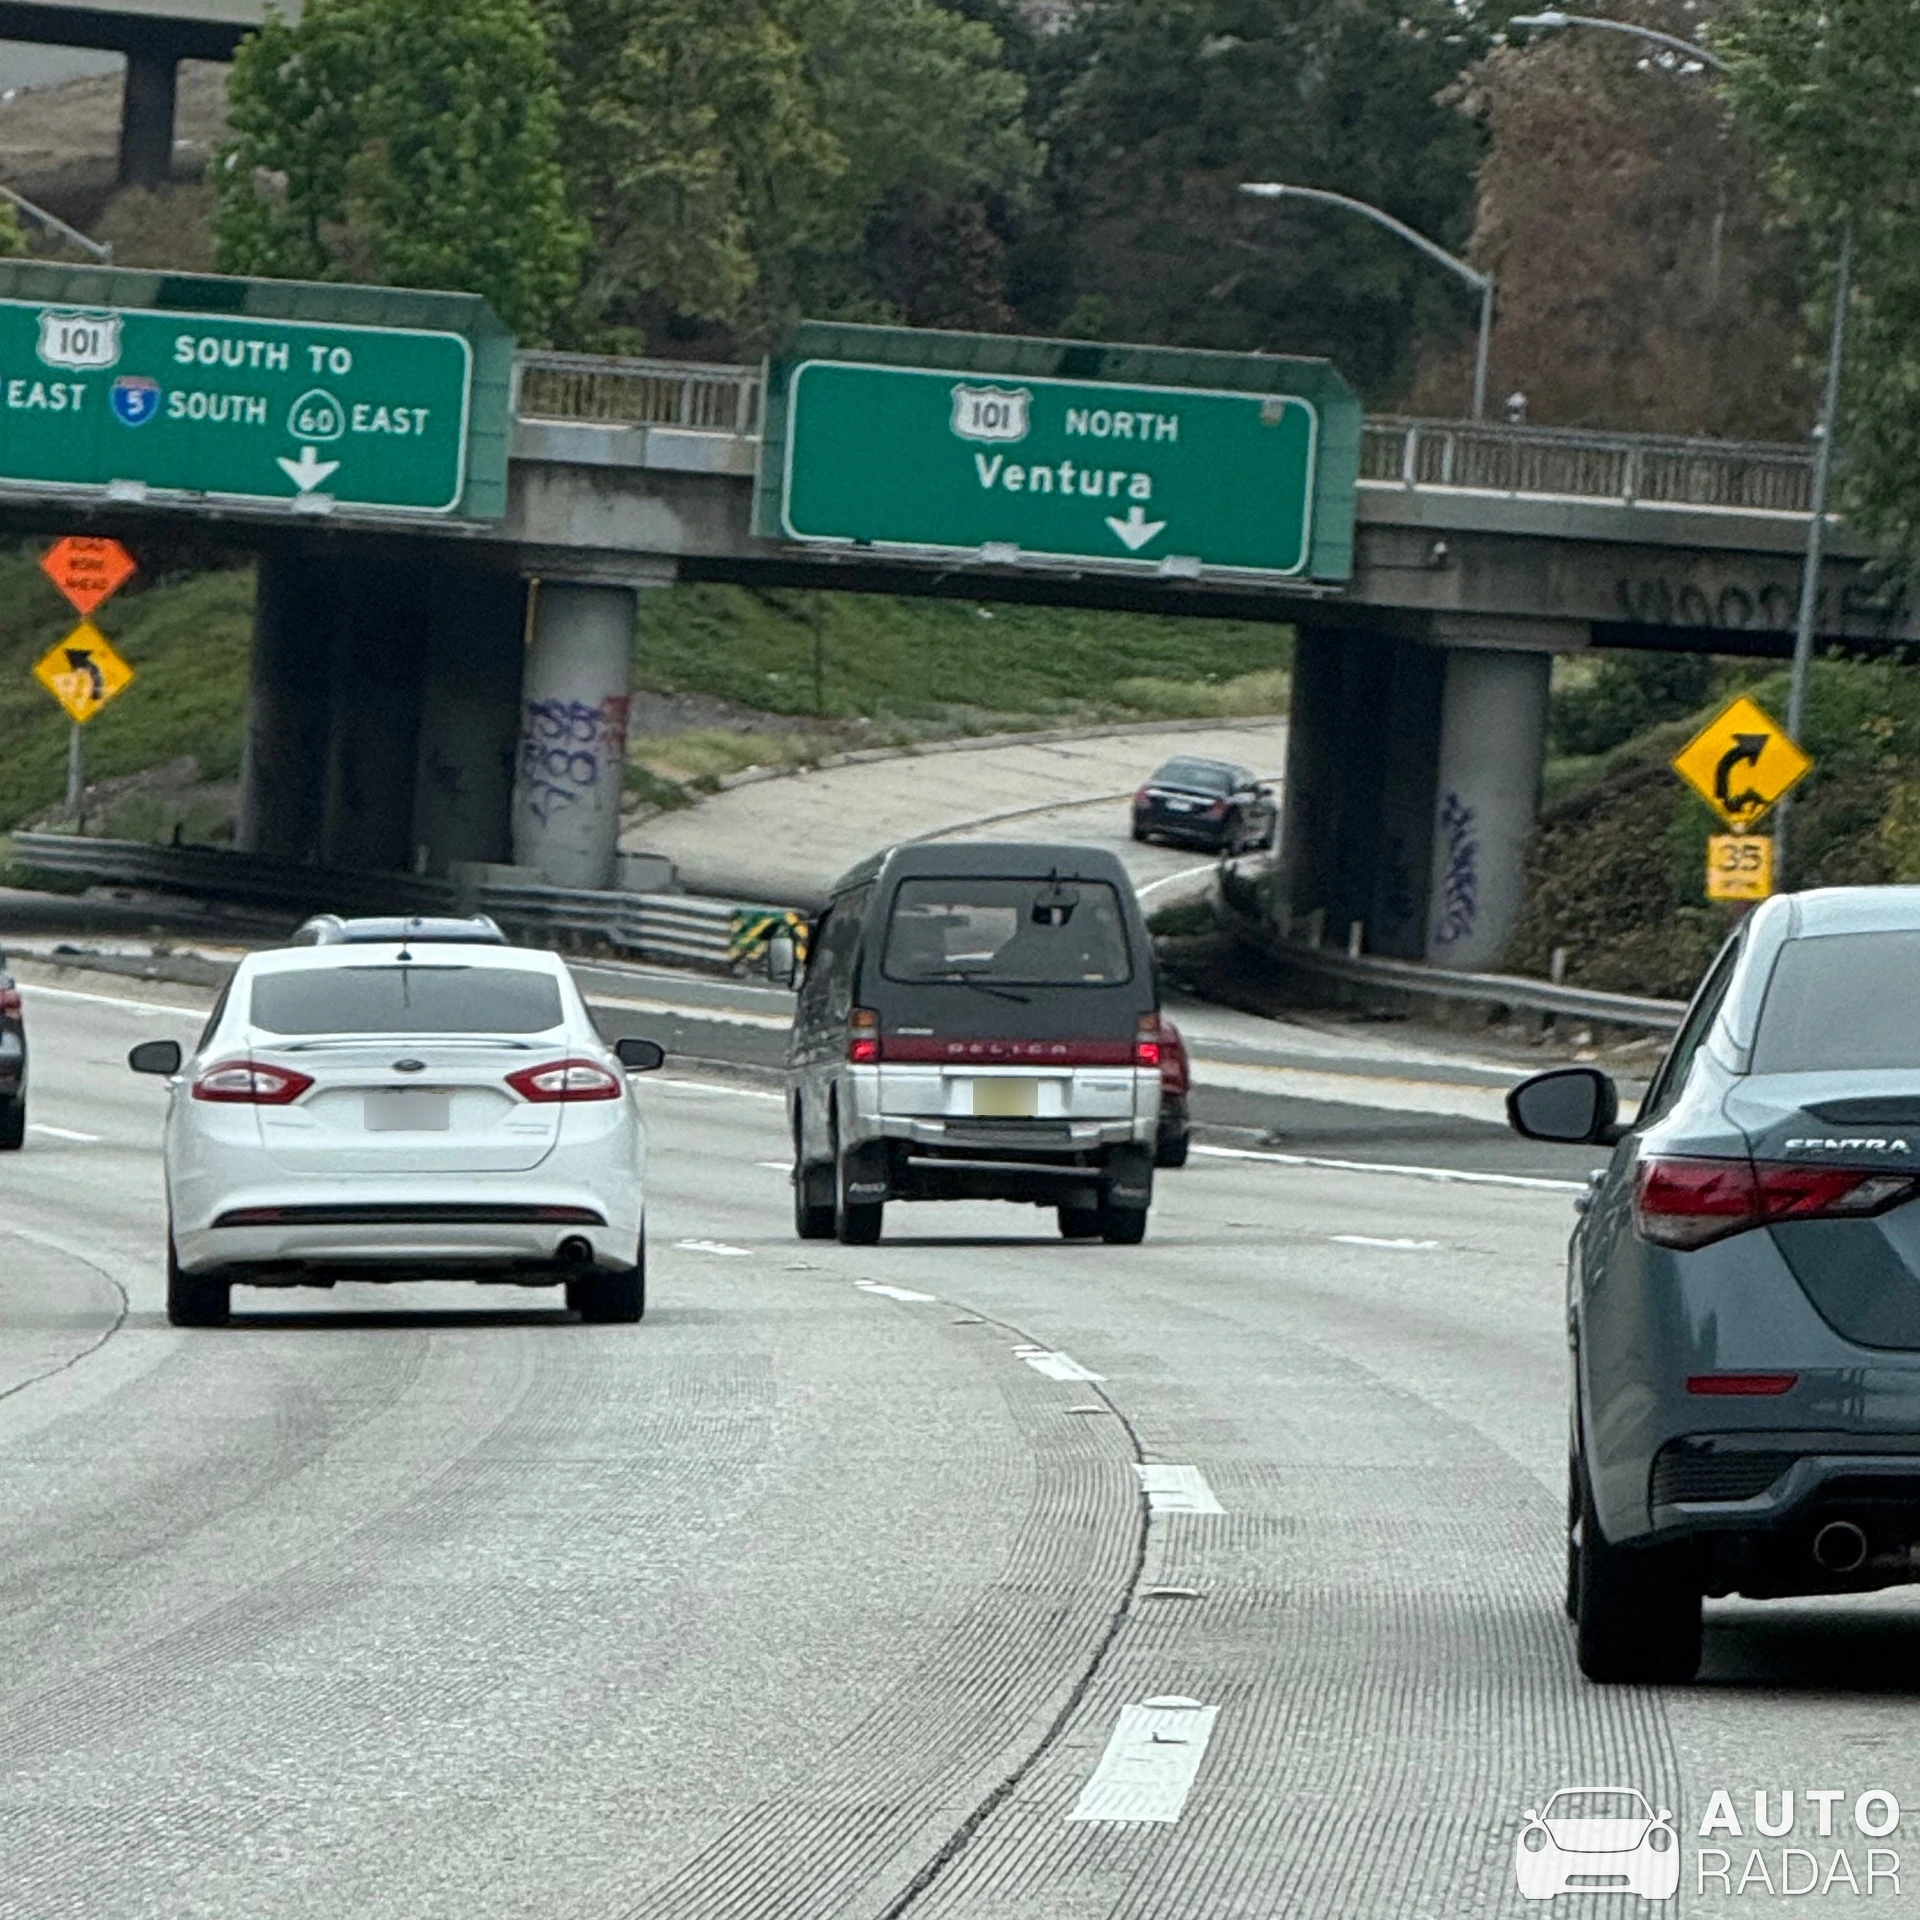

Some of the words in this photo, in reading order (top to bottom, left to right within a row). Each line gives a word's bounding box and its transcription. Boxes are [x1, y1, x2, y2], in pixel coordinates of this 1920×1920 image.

[60, 327, 99, 356] 101
[173, 335, 289, 371] SOUTH
[307, 344, 352, 375] TO
[7, 379, 87, 411] EAST
[126, 390, 145, 416] 5
[166, 390, 267, 424] SOUTH
[299, 408, 335, 433] 60
[351, 403, 430, 435] EAST
[972, 402, 1009, 430] 101
[1065, 408, 1179, 442] NORTH
[974, 452, 1151, 500] Ventura
[1718, 844, 1763, 871] 35
[1784, 1138, 1912, 1155] SENTRA
